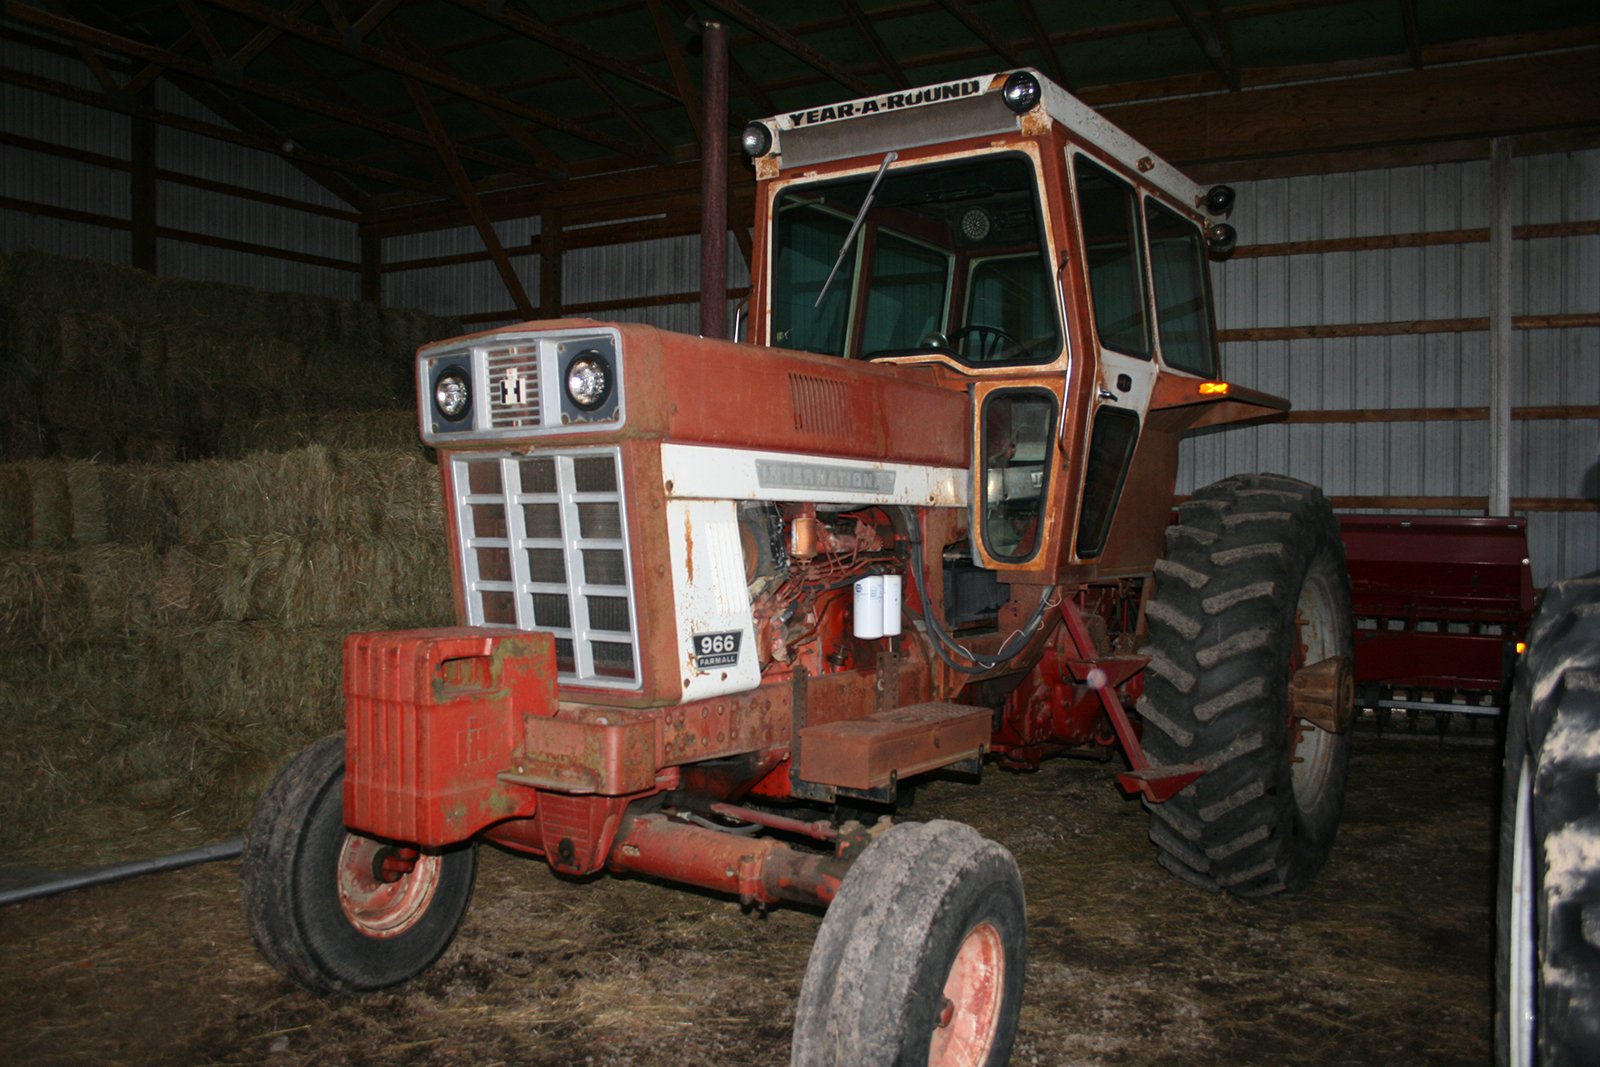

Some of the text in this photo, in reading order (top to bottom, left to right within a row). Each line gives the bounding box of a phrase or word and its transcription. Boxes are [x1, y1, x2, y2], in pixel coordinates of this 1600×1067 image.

[789, 80, 980, 126] YEAR-A-ROUND
[762, 464, 892, 491] INTERNATIONA
[701, 634, 735, 654] 966
[700, 655, 736, 666] FARMALL
